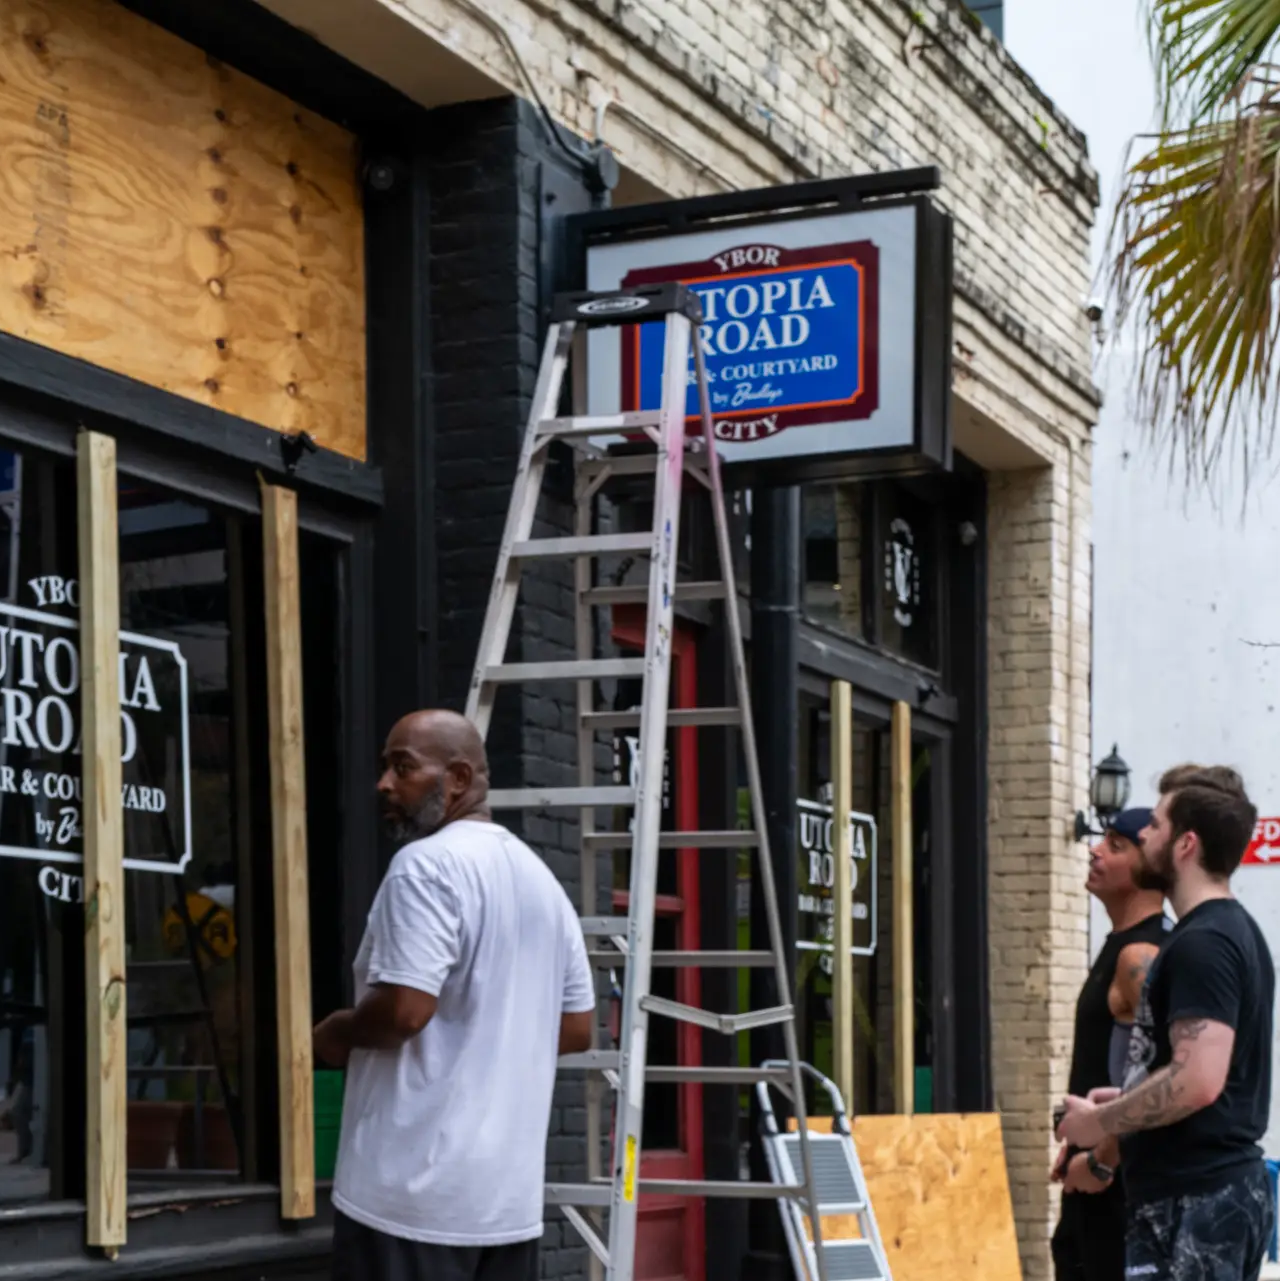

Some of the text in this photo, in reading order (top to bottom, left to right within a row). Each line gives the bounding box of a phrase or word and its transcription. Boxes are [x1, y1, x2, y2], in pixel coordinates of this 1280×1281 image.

[714, 246, 781, 272] YBOR
[689, 275, 836, 323] TOPIA
[720, 354, 838, 382] COURTYARD
[714, 414, 779, 440] CITY
[28, 575, 81, 608] YBO
[0, 688, 137, 764] ROD
[21, 768, 39, 797] &
[35, 812, 53, 843] by
[38, 866, 84, 903] CIT
